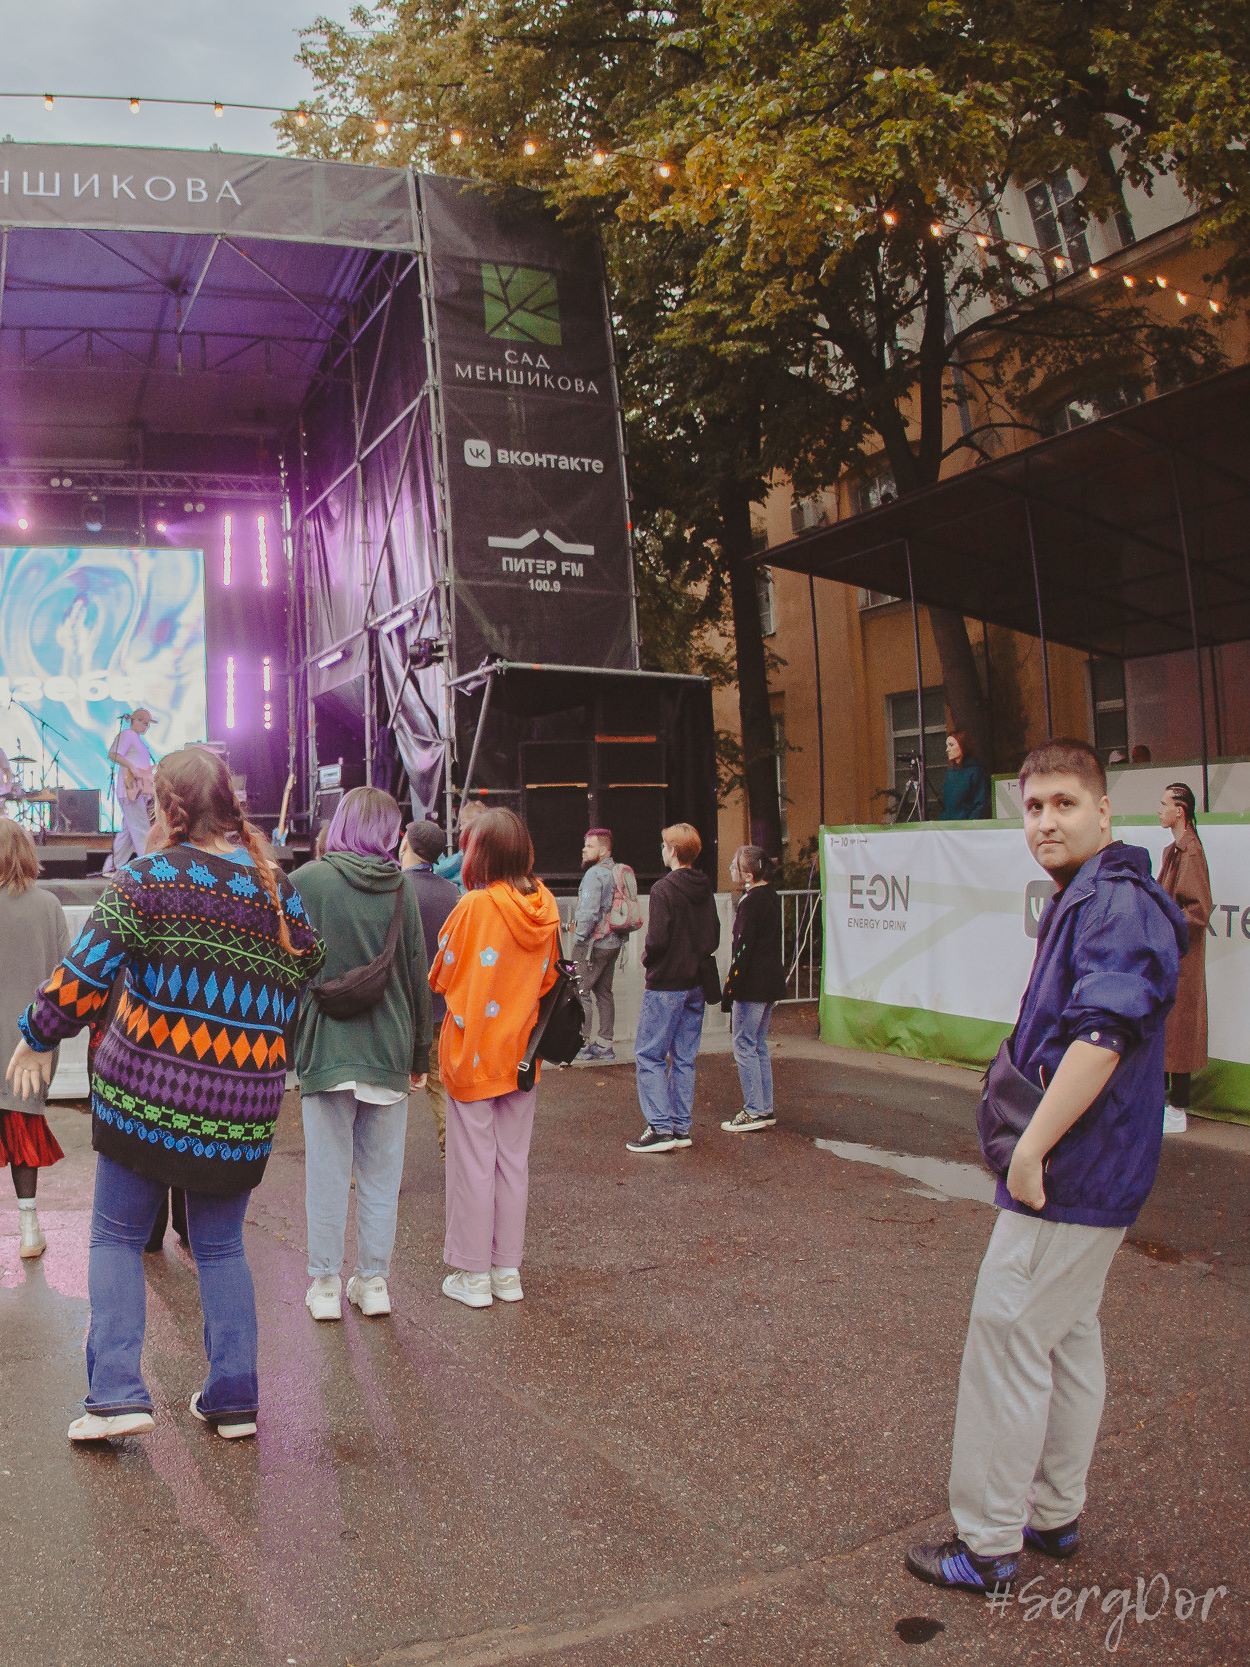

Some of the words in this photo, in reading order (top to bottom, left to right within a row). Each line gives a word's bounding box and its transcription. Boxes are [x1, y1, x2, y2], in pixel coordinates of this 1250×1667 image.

[504, 349, 551, 370] САД
[454, 363, 599, 394] МЕНШИКОВА
[502, 556, 557, 575] ПИТЕР
[561, 561, 584, 577] FM
[528, 579, 561, 593] 100.9
[847, 917, 881, 929] ENERGY
[882, 919, 908, 931] DRINK
